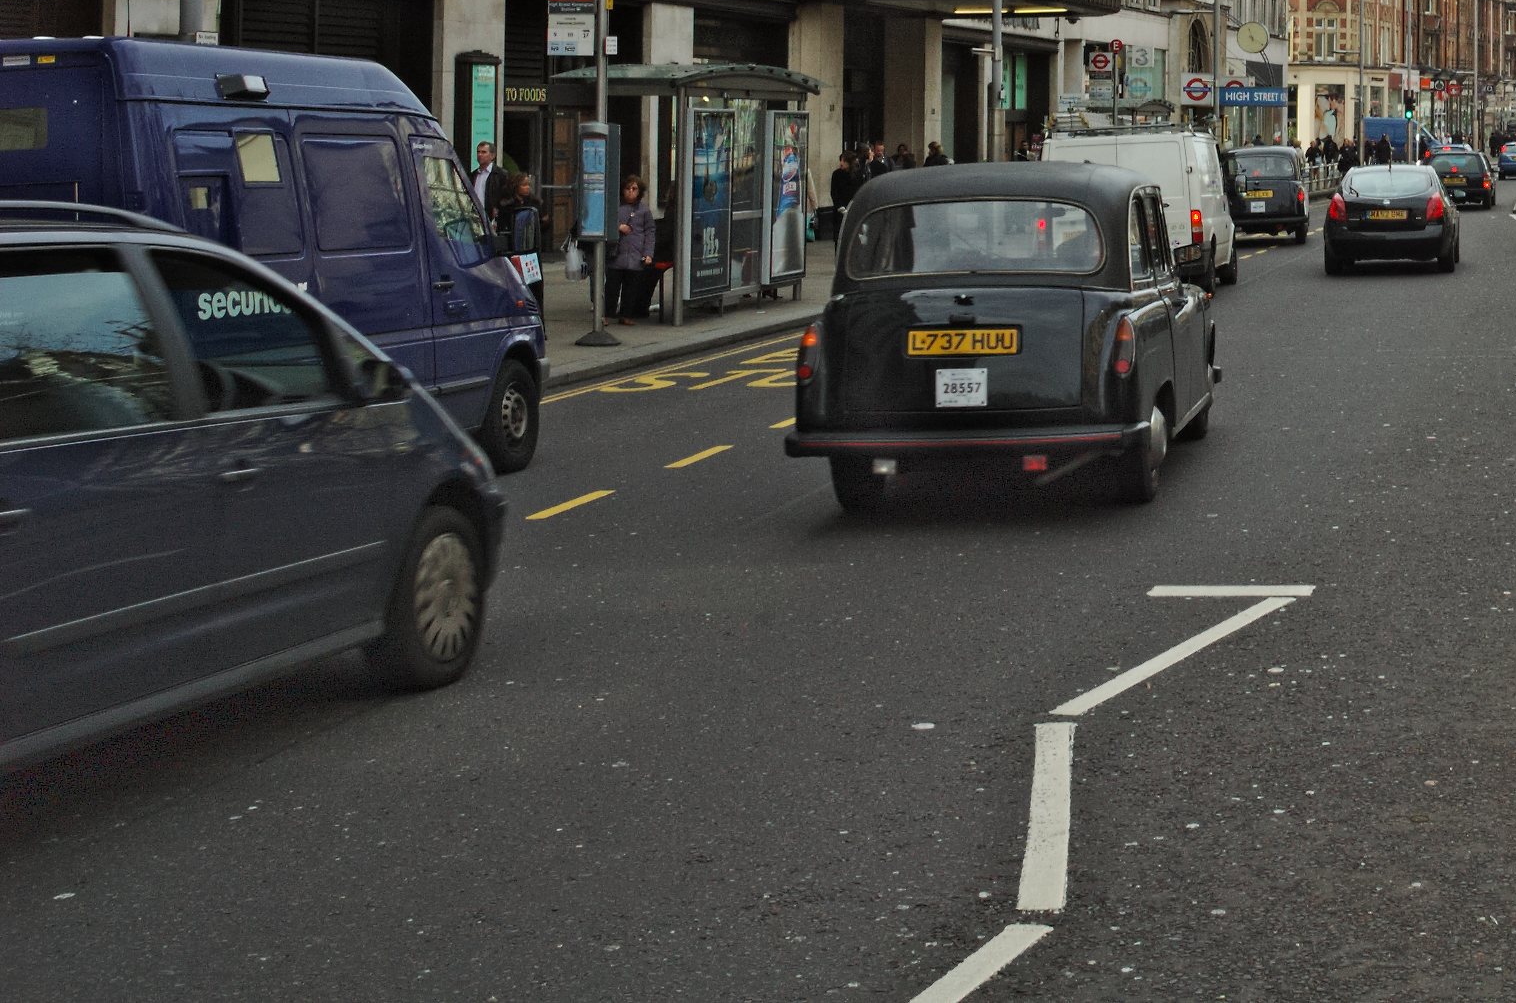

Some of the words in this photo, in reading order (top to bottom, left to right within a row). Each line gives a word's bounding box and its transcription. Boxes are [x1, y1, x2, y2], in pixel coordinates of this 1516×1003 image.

[1113, 42, 1120, 50] E
[1135, 48, 1148, 66] 3
[505, 88, 517, 101] TO
[519, 88, 547, 102] FOODS
[1225, 91, 1250, 101] HIGH
[1254, 92, 1279, 102] STREET
[912, 332, 967, 351] L737
[971, 332, 1014, 350] HUU
[943, 382, 982, 394] 28557
